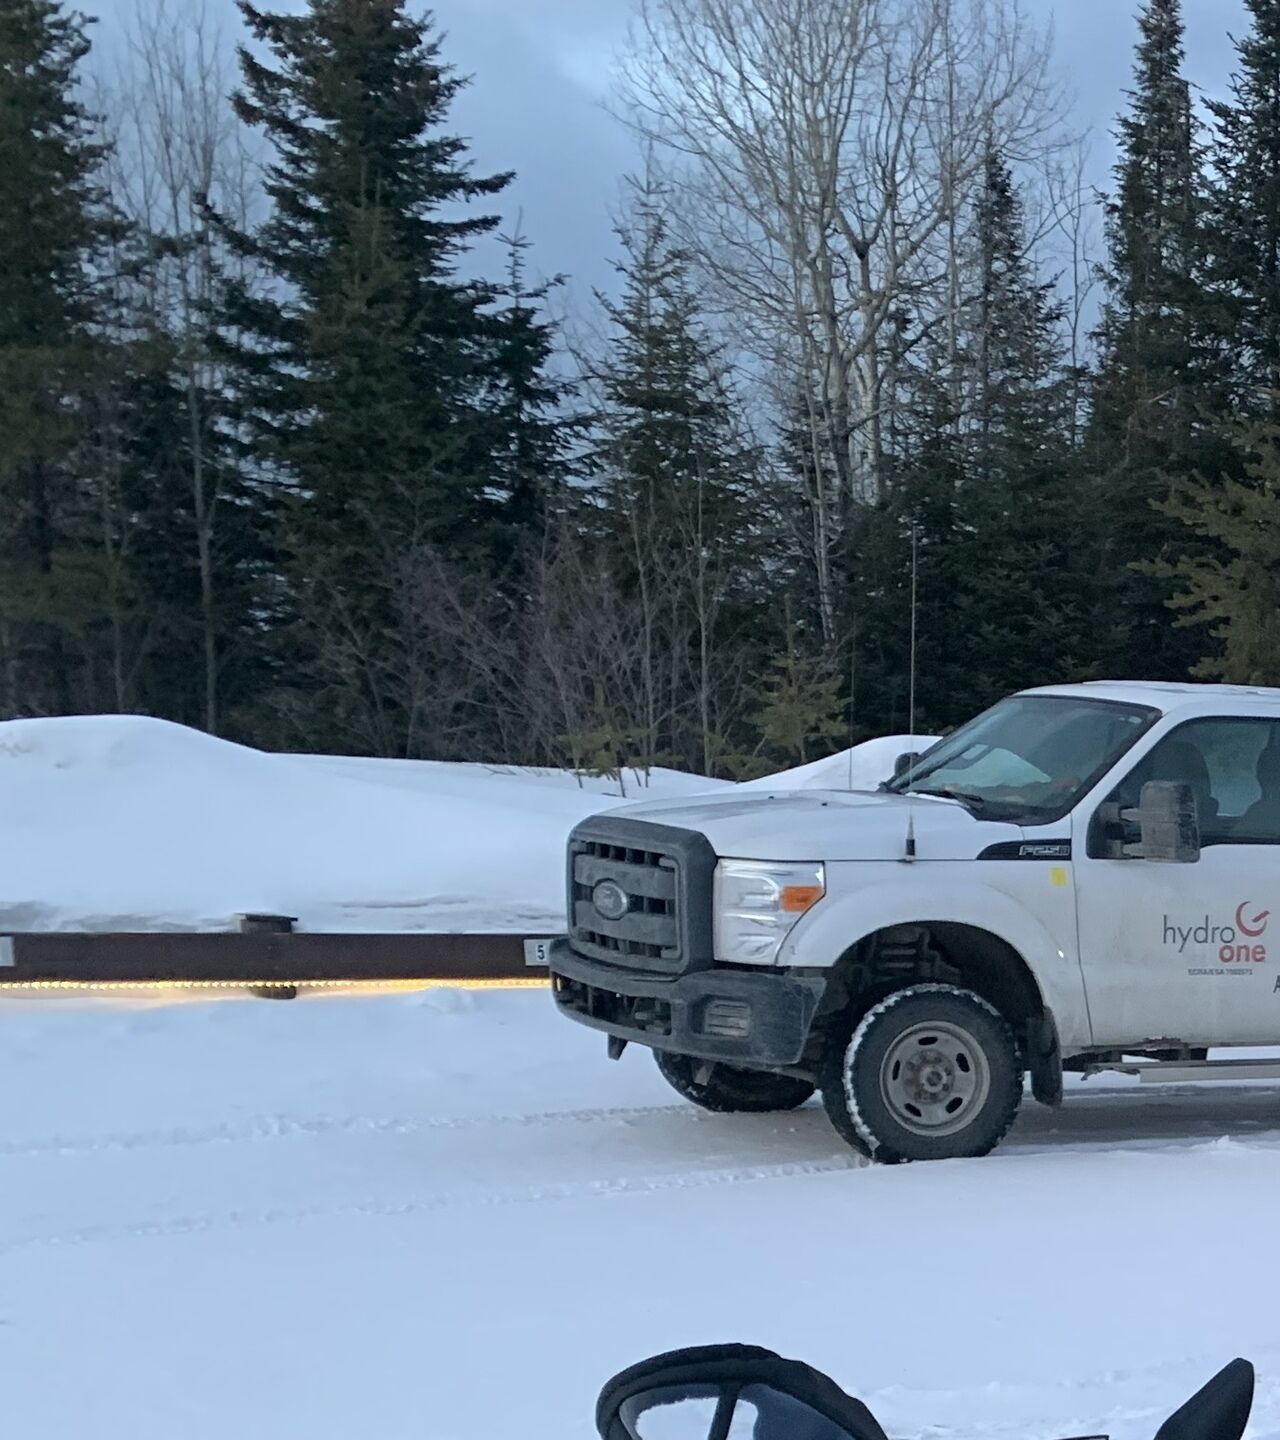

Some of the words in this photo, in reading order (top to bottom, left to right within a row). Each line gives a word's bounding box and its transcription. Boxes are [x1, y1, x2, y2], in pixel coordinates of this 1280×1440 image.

[1162, 914, 1236, 953] hydro
[536, 944, 546, 960] 5
[1218, 944, 1267, 963] one
